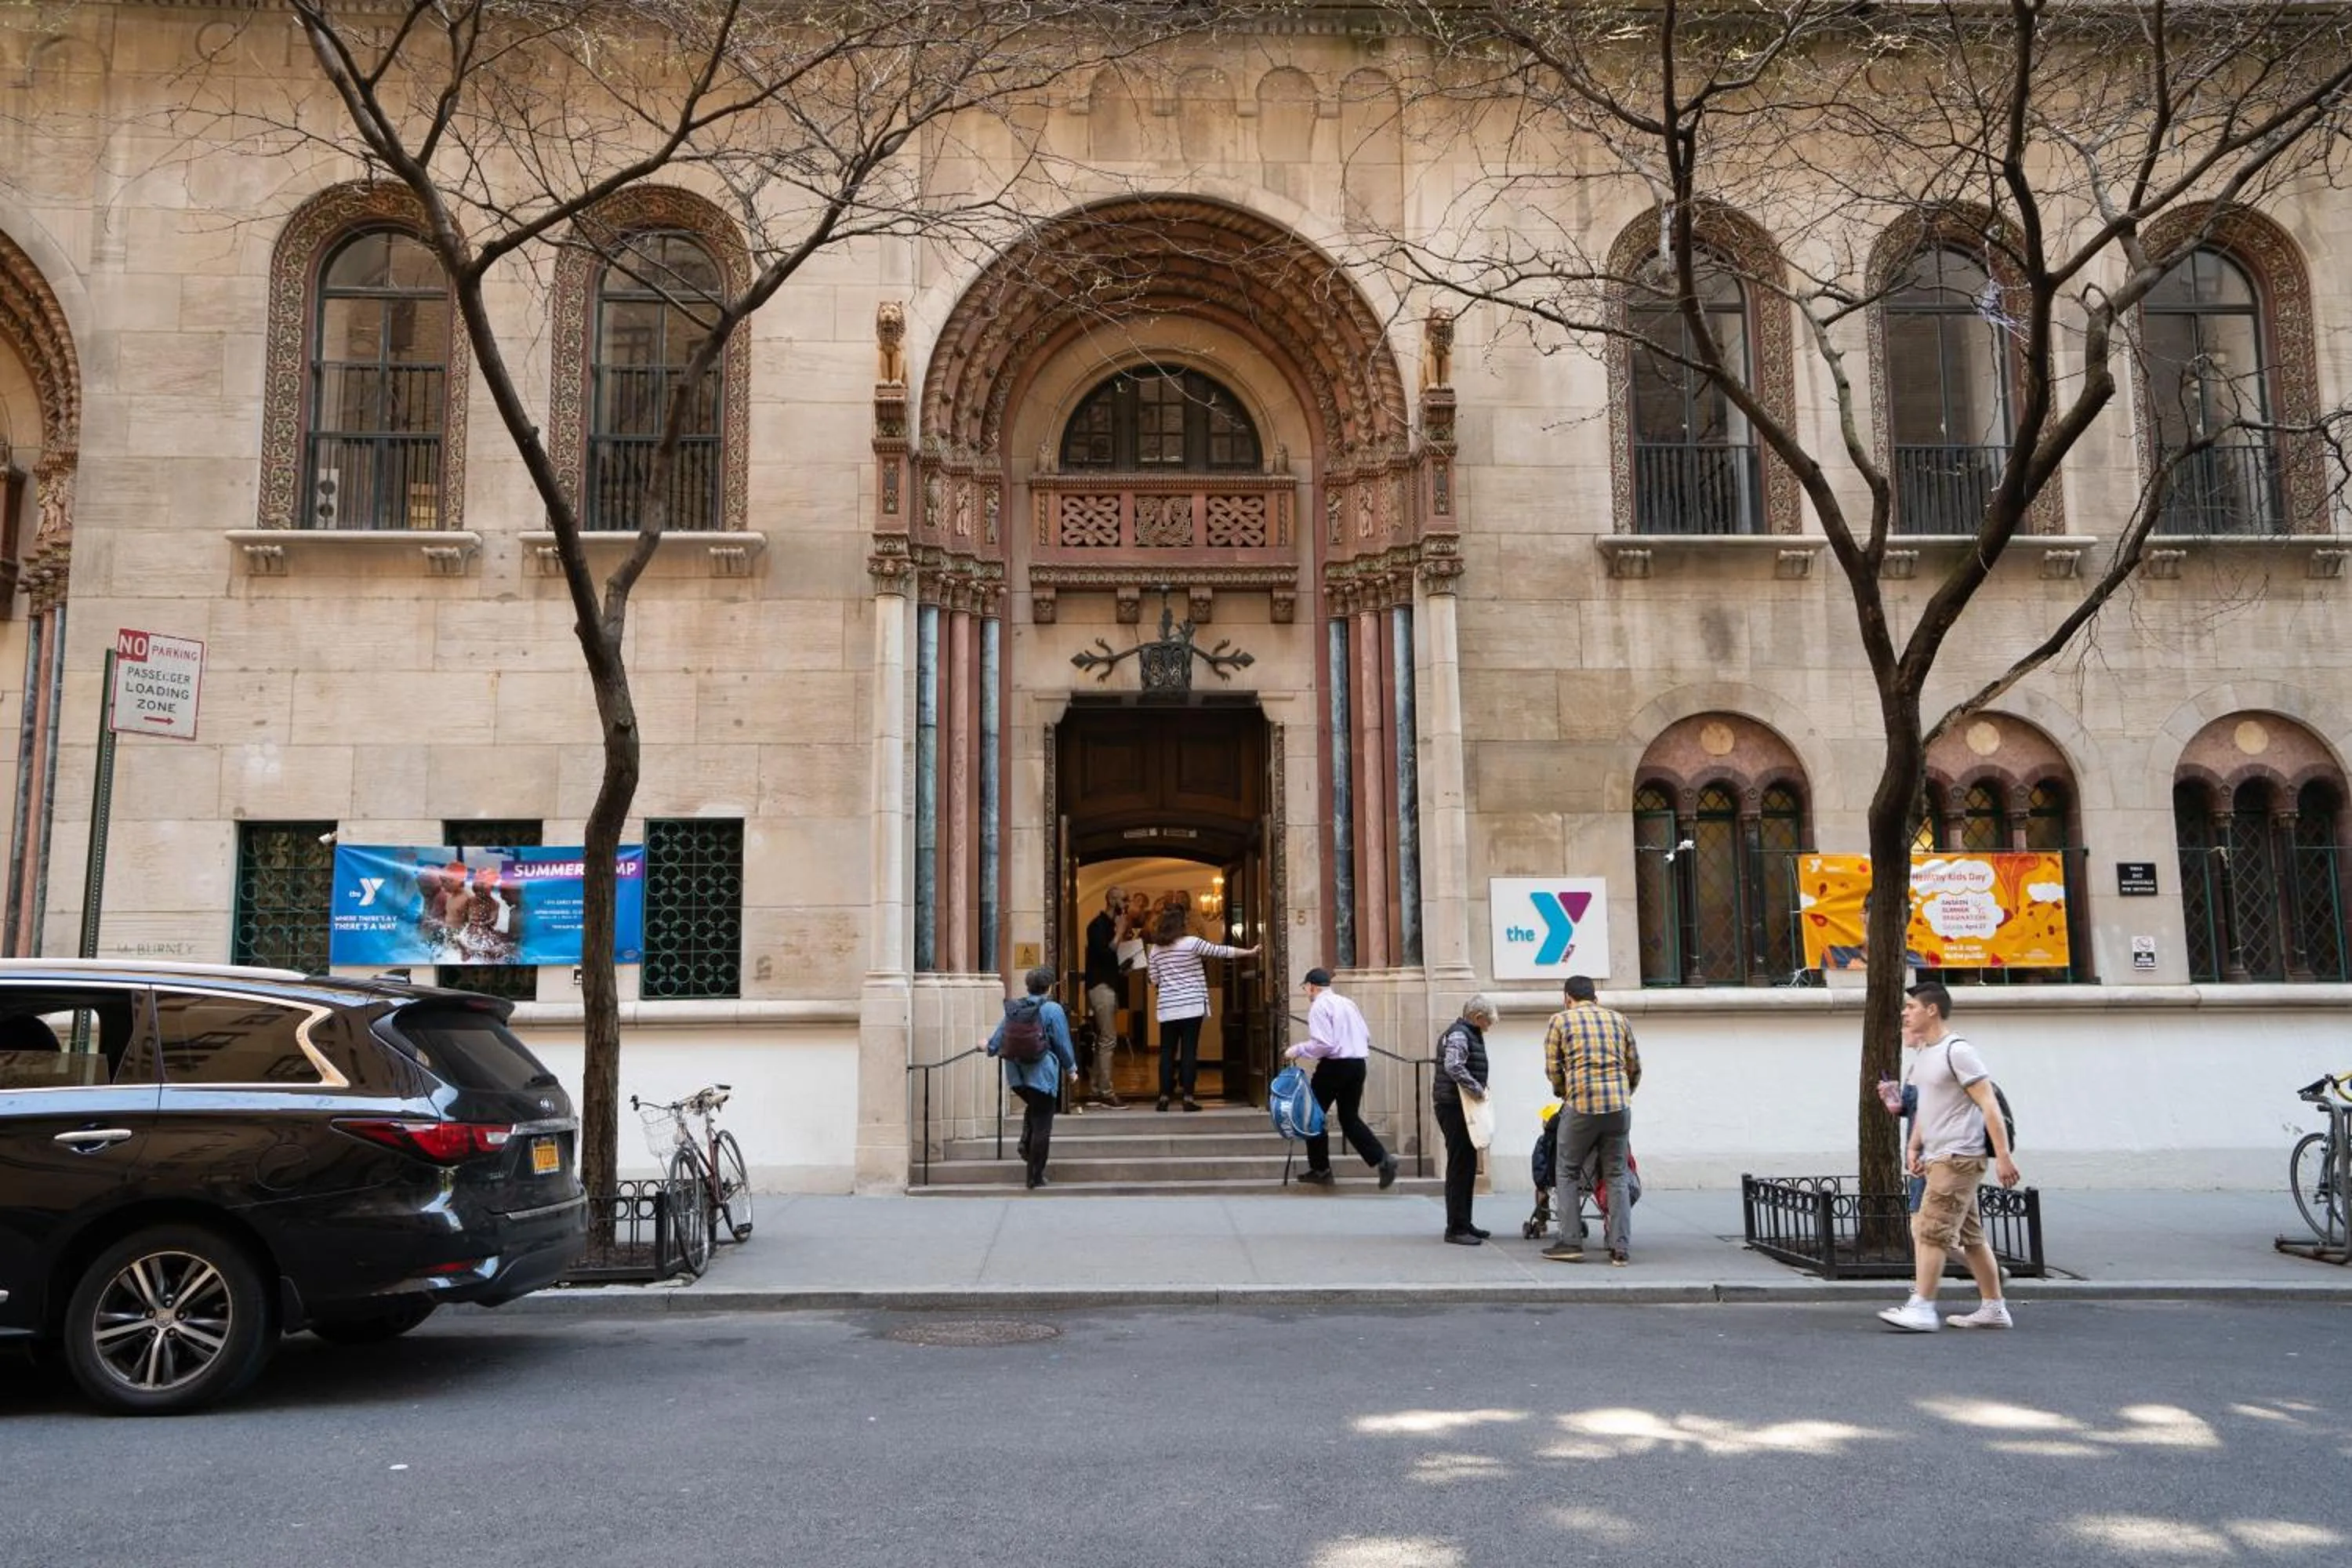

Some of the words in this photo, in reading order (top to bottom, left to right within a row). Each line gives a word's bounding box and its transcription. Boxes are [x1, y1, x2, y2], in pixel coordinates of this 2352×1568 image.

[119, 634, 147, 656] NO
[151, 645, 198, 661] PARKING
[125, 681, 190, 700] LOADING
[136, 699, 176, 713] ZONE
[514, 863, 585, 877] SUMMER
[1948, 872, 1967, 880] Kids
[1969, 872, 1986, 883] Day
[1506, 926, 1536, 942] the
